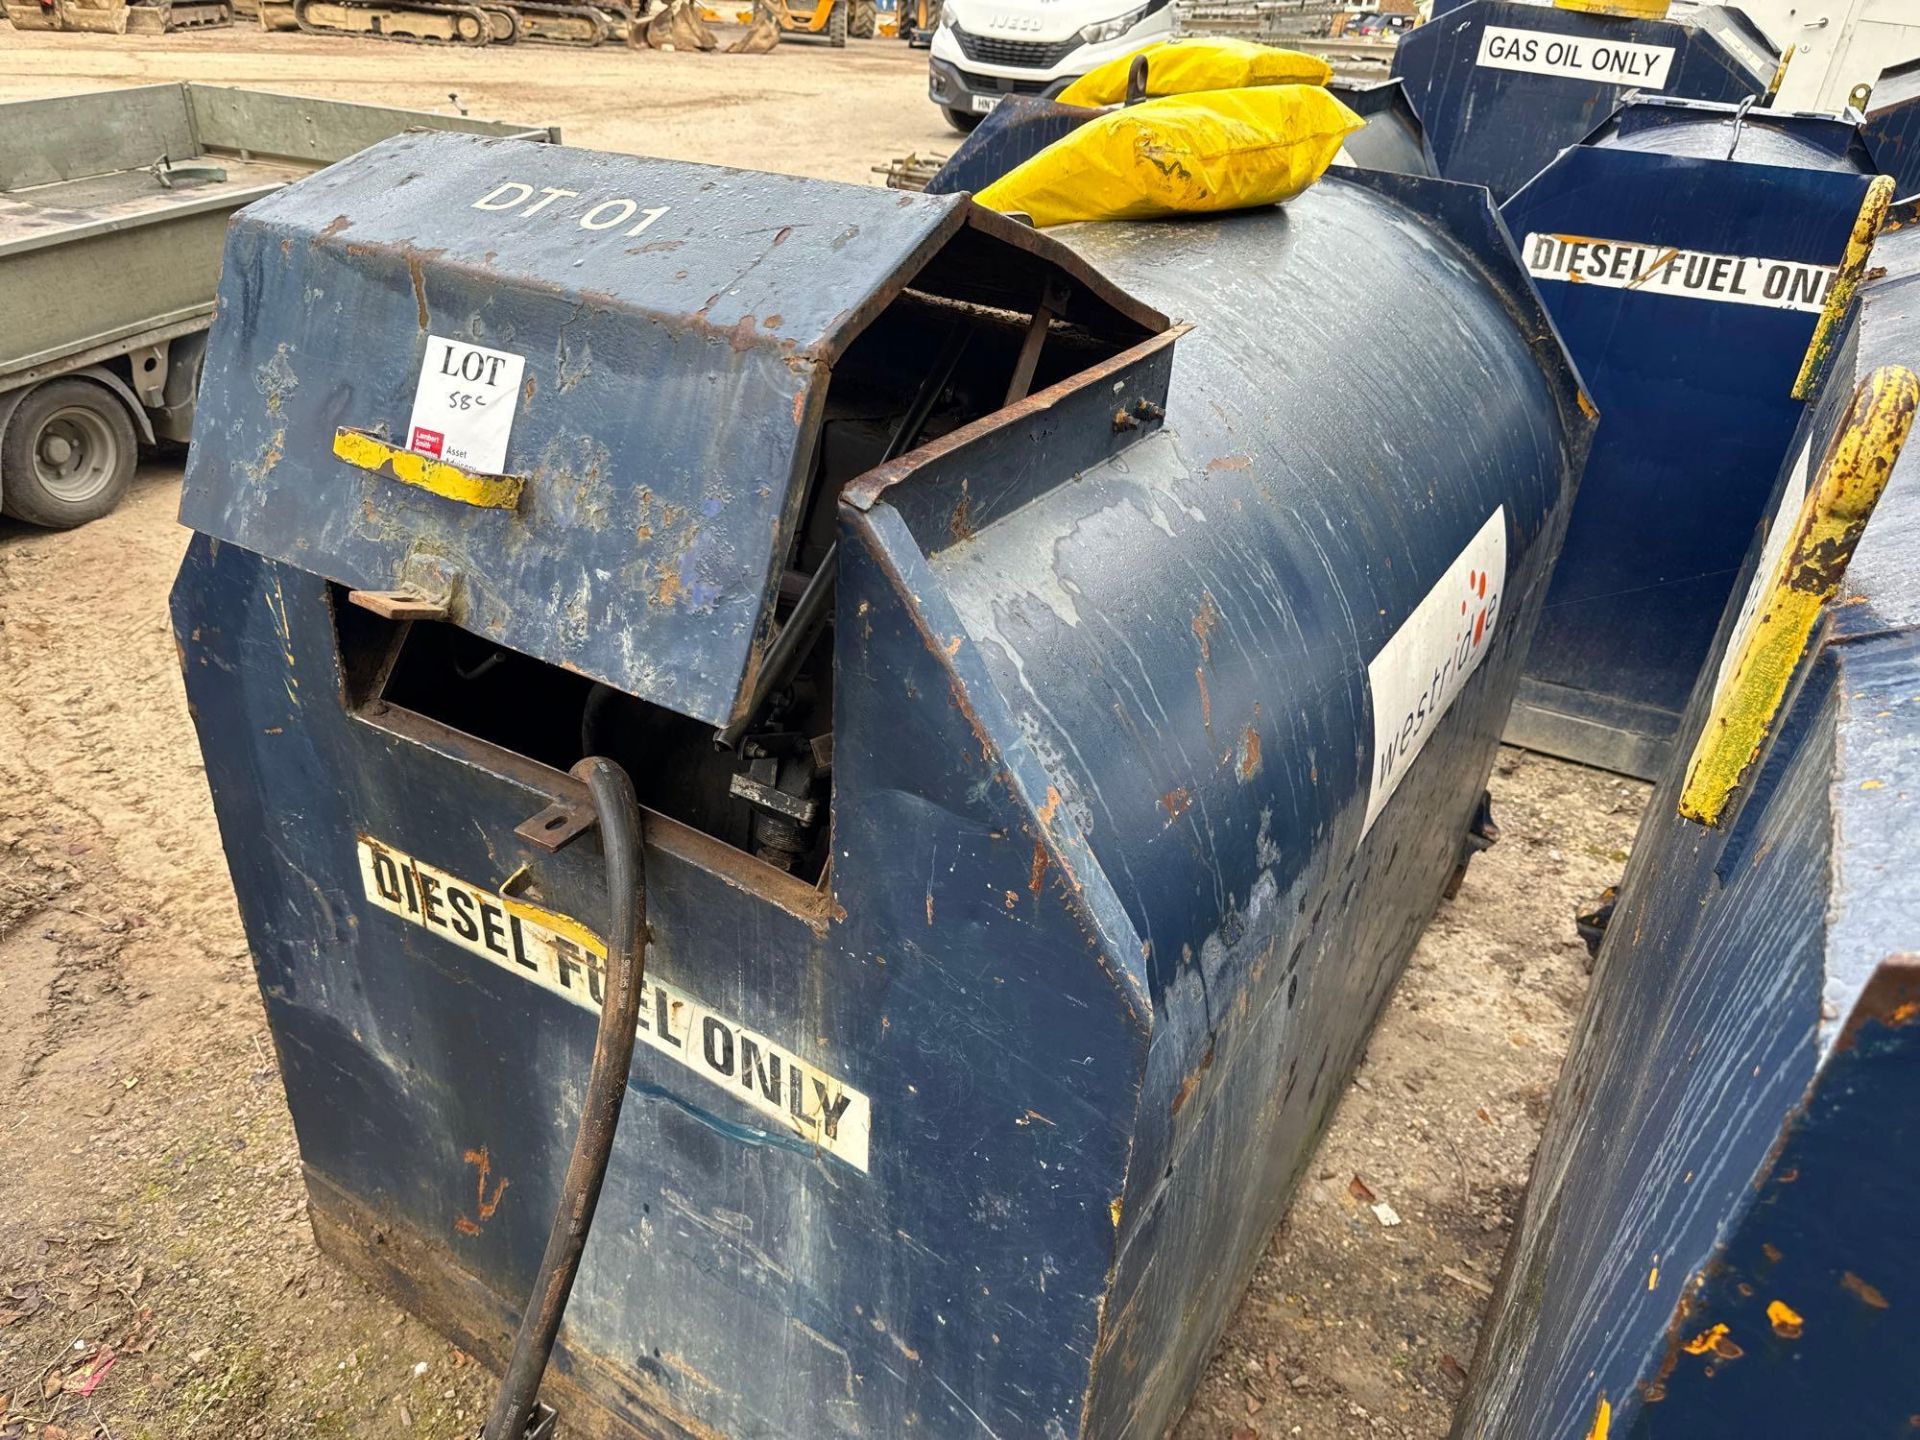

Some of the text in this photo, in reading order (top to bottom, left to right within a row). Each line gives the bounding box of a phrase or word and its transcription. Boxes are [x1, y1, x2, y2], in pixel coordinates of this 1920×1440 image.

[989, 15, 1042, 32] IVECO
[1488, 36, 1660, 77] GAS OIL ONLY
[471, 181, 579, 218] DT
[1531, 237, 1646, 282] DIESEL
[1661, 250, 1747, 295] FUEL
[440, 345, 506, 386] LOT
[415, 438, 432, 449] Smith
[416, 430, 439, 442] Lambert
[446, 445, 468, 459] Asset
[373, 851, 538, 972] DIESEL
[702, 1015, 851, 1141] ONLY
